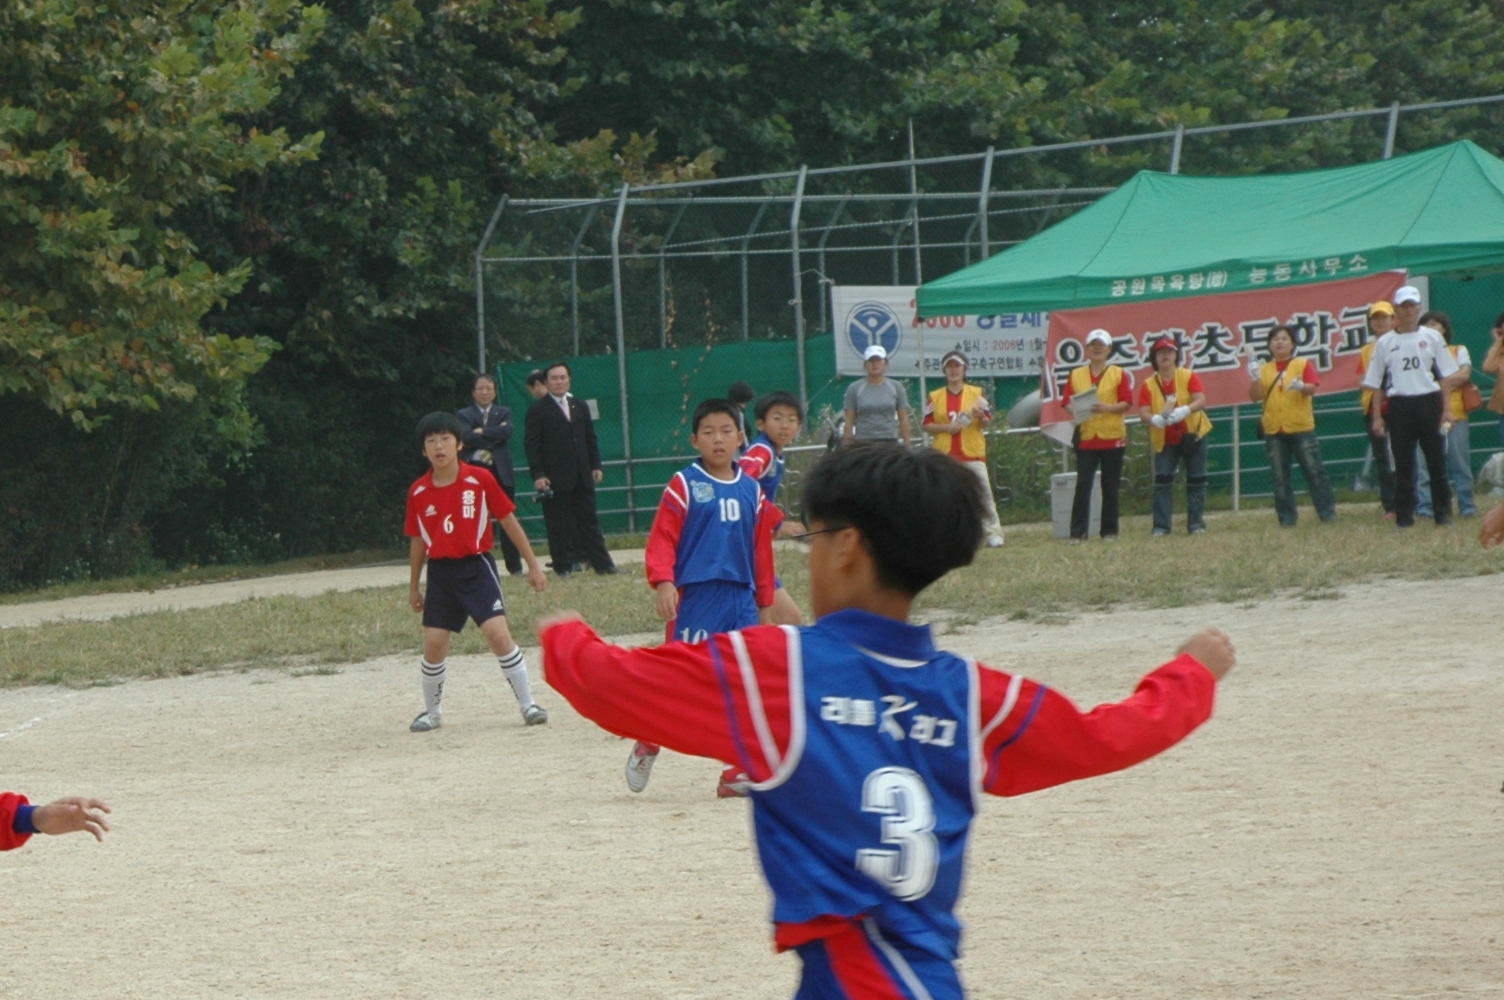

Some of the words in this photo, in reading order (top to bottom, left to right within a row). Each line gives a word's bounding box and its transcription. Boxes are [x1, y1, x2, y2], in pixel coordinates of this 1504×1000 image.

[1403, 356, 1421, 371] 20
[462, 490, 476, 520] 용마
[719, 498, 741, 522] 10
[443, 514, 454, 534] 6
[855, 766, 940, 902] 3
